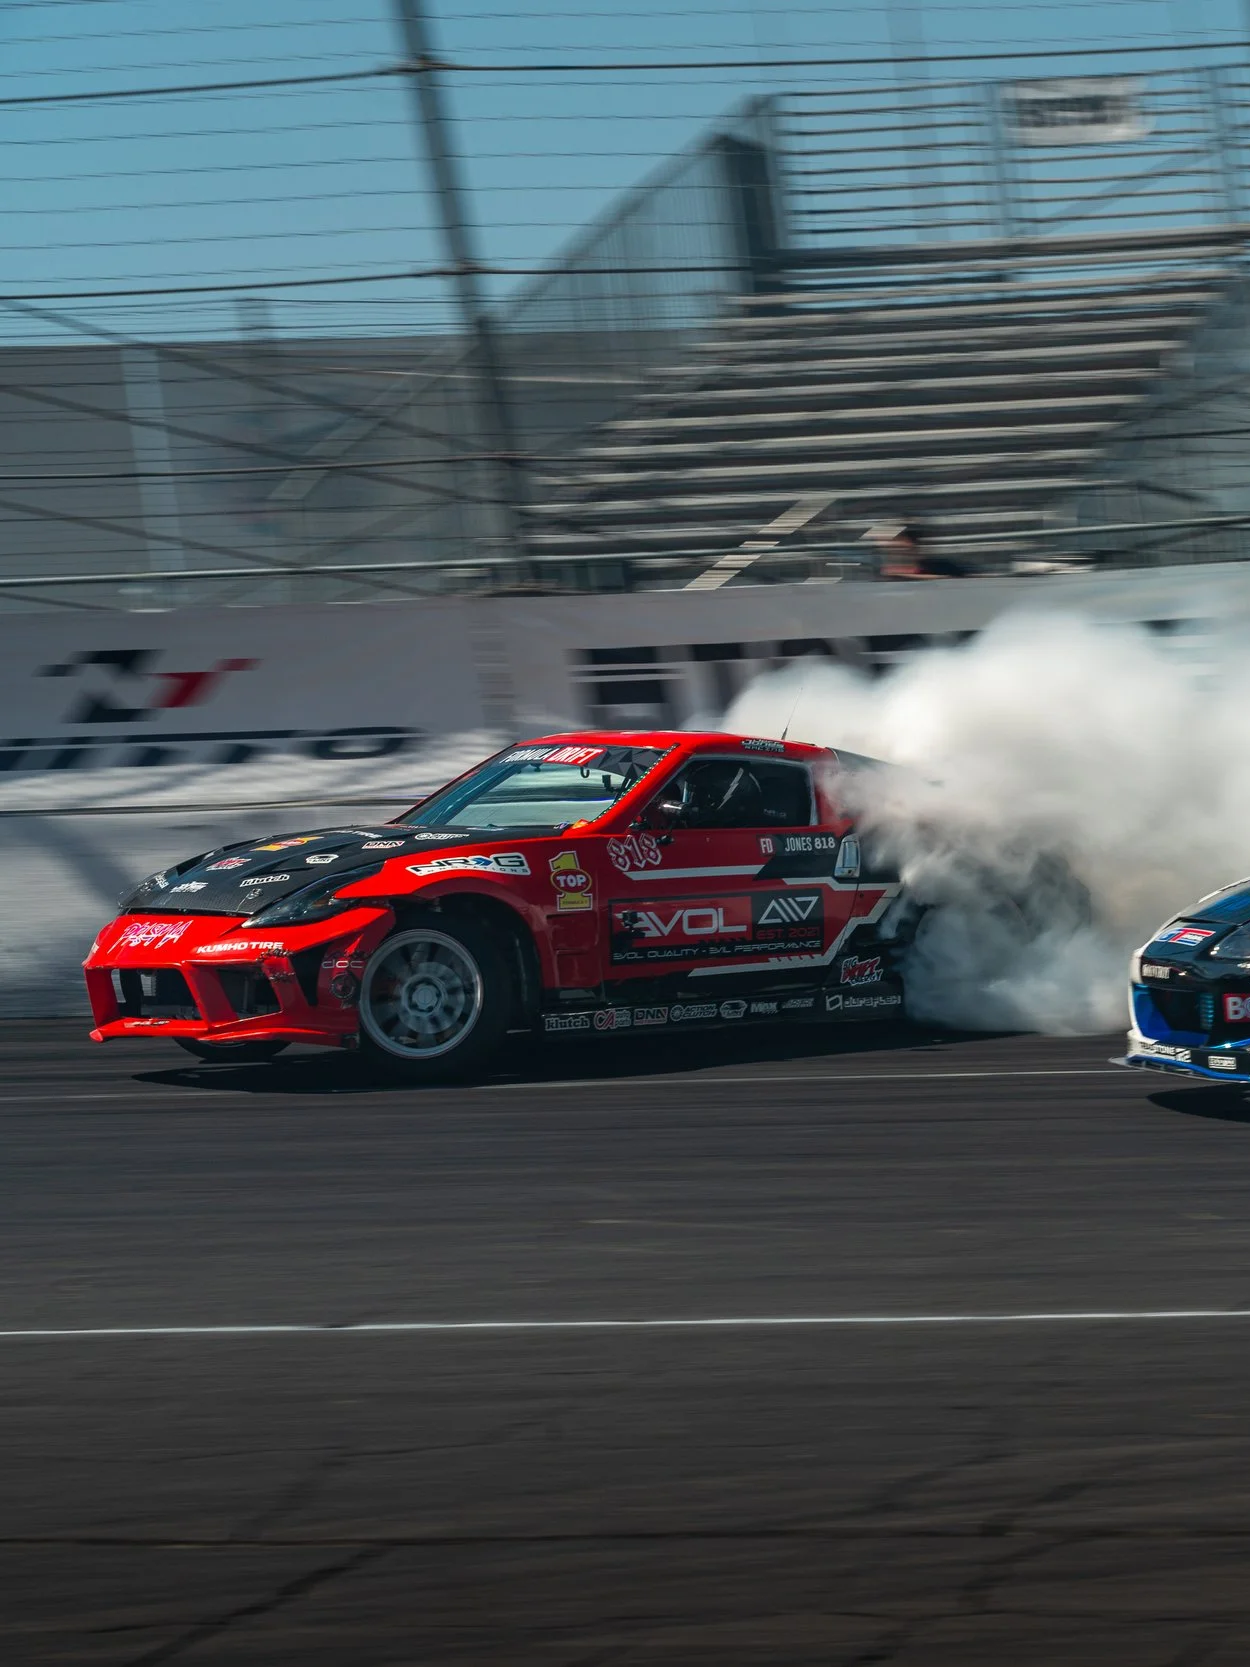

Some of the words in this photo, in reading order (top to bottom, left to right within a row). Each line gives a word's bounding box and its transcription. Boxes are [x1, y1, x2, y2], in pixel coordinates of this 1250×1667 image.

[545, 747, 603, 764] DRIFT
[760, 838, 773, 853] FD
[785, 837, 812, 852] JONES
[814, 837, 836, 849] 818
[556, 875, 586, 888] TOP
[196, 942, 249, 953] KUMHO
[250, 941, 284, 950] TIRE
[648, 948, 699, 958] QUALITY
[635, 1009, 666, 1020] DNA
[546, 1016, 589, 1030] klutch
